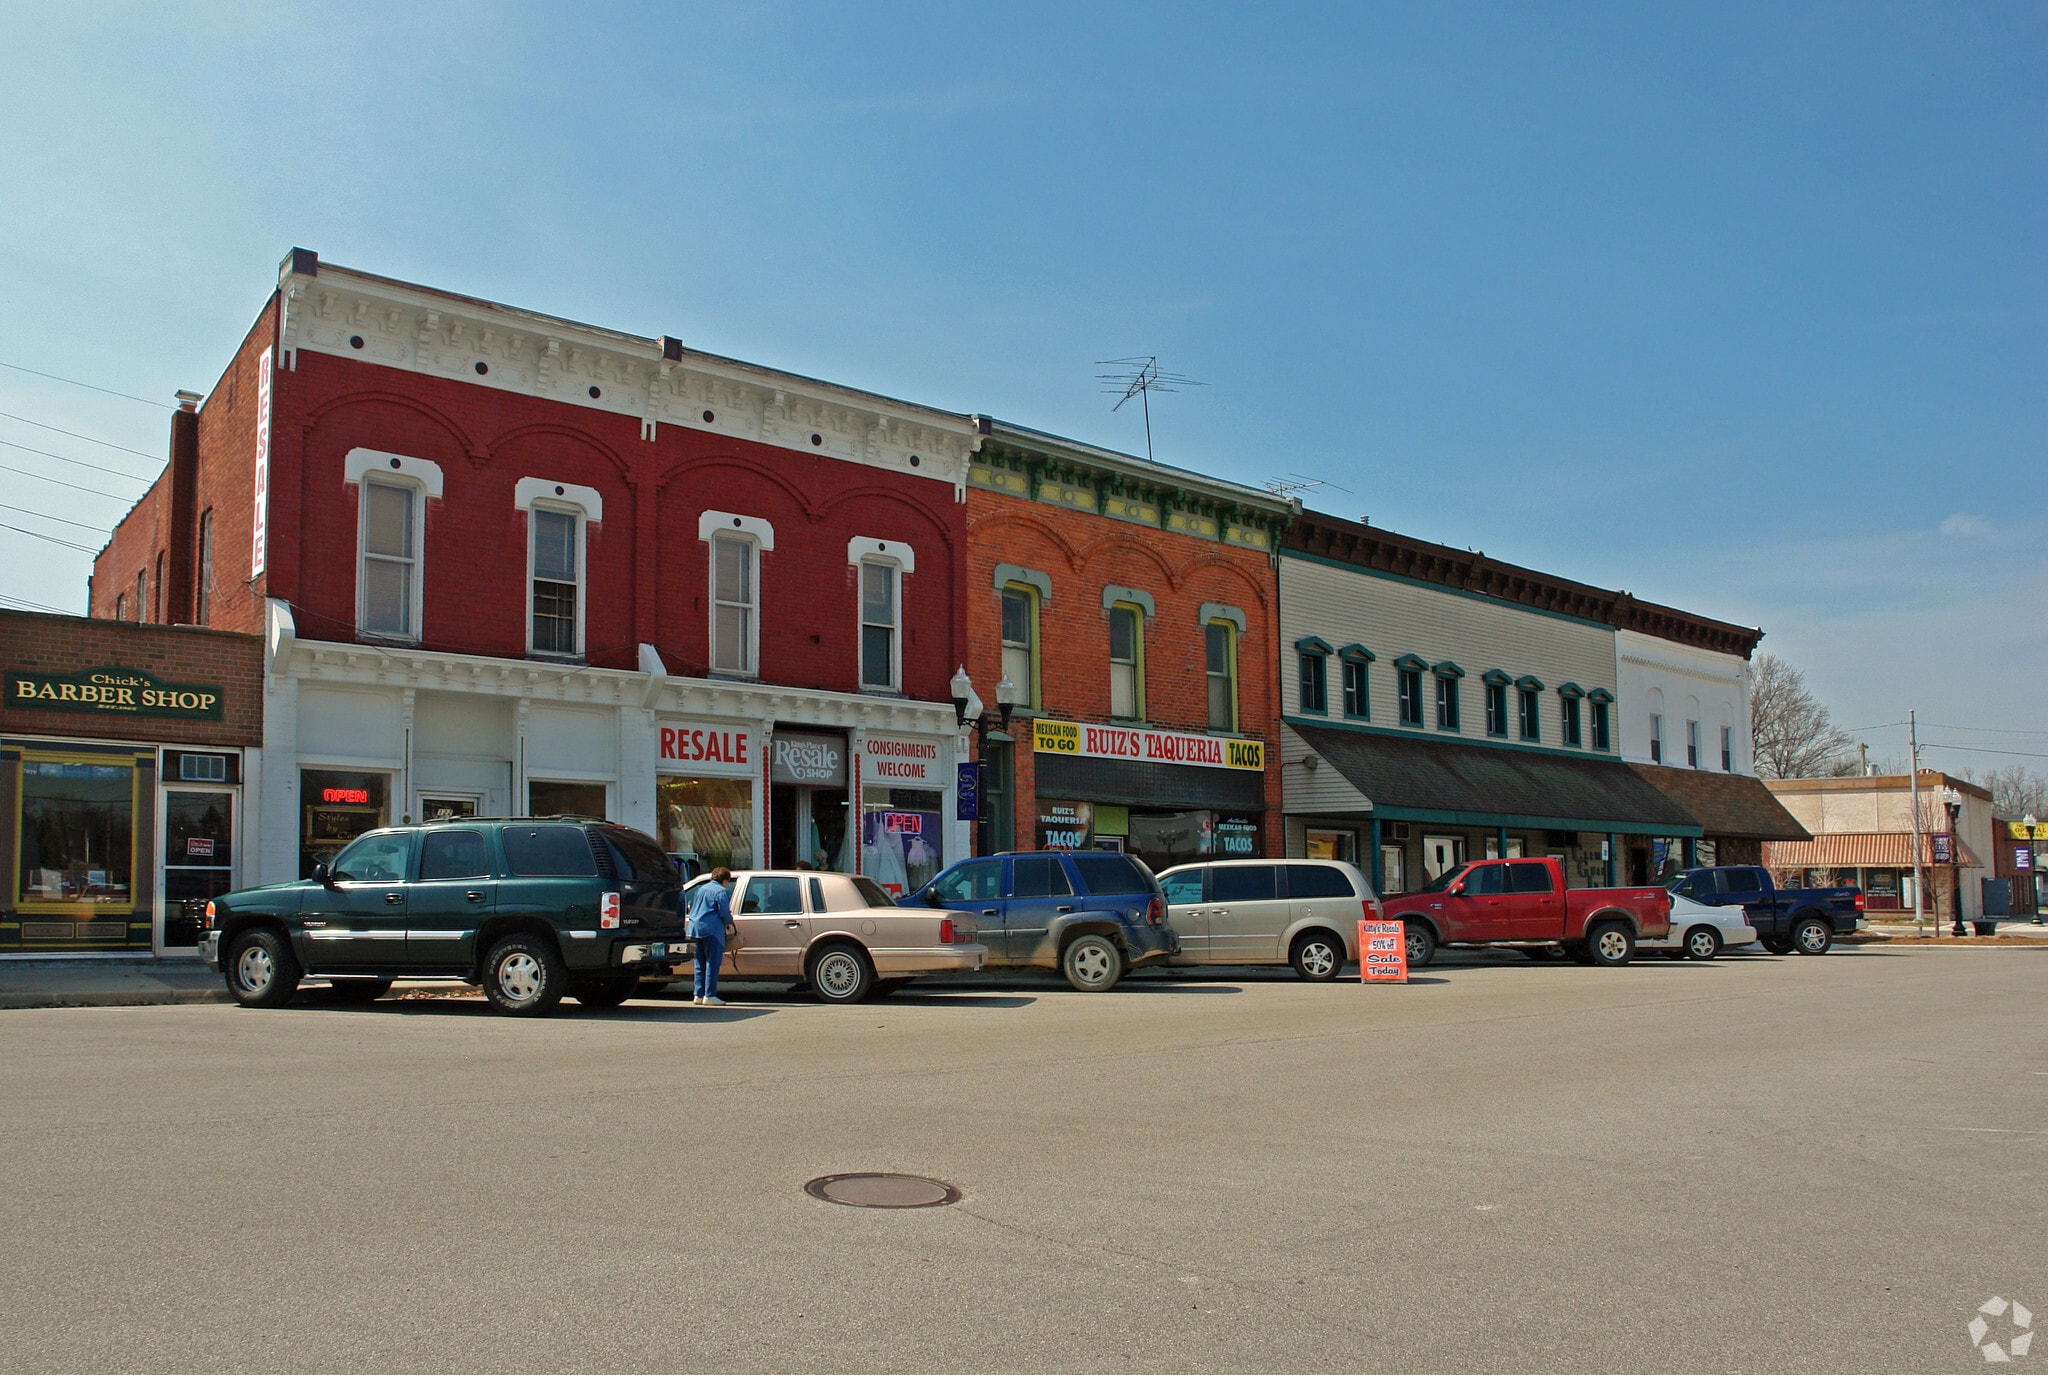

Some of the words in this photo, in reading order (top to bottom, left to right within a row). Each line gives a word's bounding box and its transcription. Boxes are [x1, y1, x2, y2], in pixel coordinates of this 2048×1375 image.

[254, 356, 270, 568] RESALE
[90, 674, 151, 687] Chick's
[16, 680, 136, 705] BARBER
[141, 689, 216, 710] SHOP
[1035, 722, 1062, 737] MEXICAN
[1062, 727, 1077, 738] FOOD
[660, 728, 748, 763] RESALE
[867, 739, 937, 759] CONSIGNMENTS
[1038, 737, 1055, 749] TO
[1057, 739, 1075, 751] GO
[1086, 728, 1140, 757] RUIZ'S
[1144, 733, 1222, 764] TAQUERIA
[774, 740, 838, 779] Resale
[1229, 742, 1260, 767] TACOS
[806, 768, 832, 779] SHOP
[877, 761, 926, 778] WELCOME
[323, 788, 367, 803] OPEN
[318, 812, 349, 822] Styles
[1052, 806, 1075, 815] RUIZ'S
[886, 814, 920, 832] OPEN
[1040, 815, 1086, 825] TAQUERIA
[1218, 823, 1242, 831] MEXICAN
[326, 823, 338, 833] by
[1045, 830, 1082, 847] TACOS
[1224, 836, 1253, 852] TACOS
[1372, 940, 1386, 950] 50%
[1387, 939, 1395, 950] off
[1367, 954, 1402, 963] Sale
[1369, 966, 1399, 976] Today
